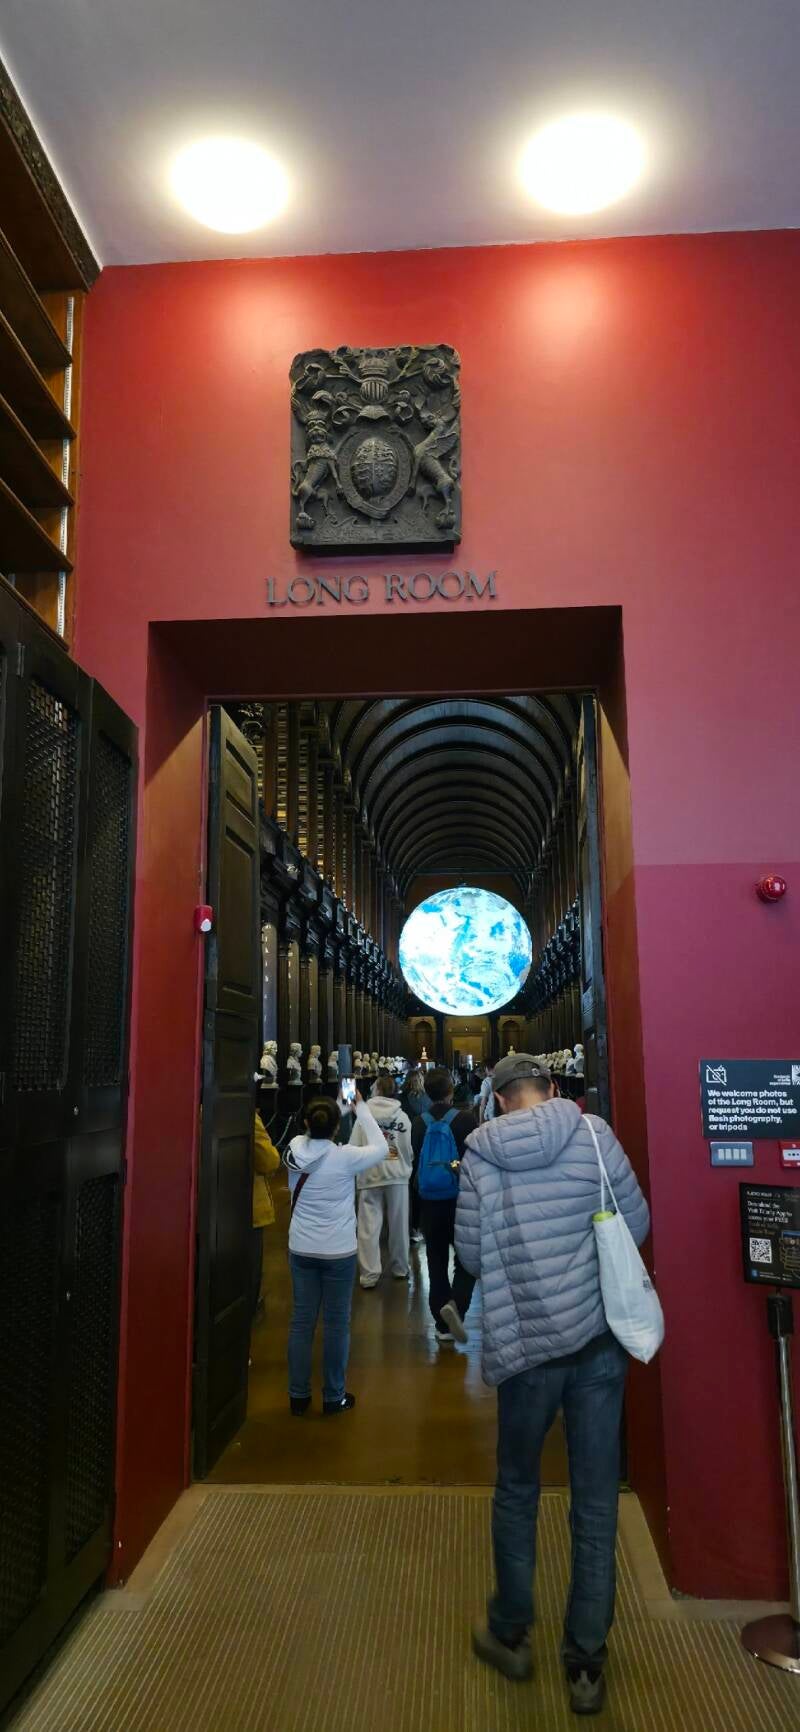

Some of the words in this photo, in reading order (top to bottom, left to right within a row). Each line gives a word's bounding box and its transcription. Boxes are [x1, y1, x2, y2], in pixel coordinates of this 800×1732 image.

[266, 575, 370, 607] LONG
[384, 570, 498, 603] ROOM
[759, 1090, 787, 1098] photos
[731, 1098, 752, 1107] Long
[752, 1098, 779, 1106] Room,
[779, 1098, 794, 1106] but
[708, 1107, 739, 1115] request
[729, 1115, 783, 1124] photography,
[718, 1123, 748, 1132] tripods
